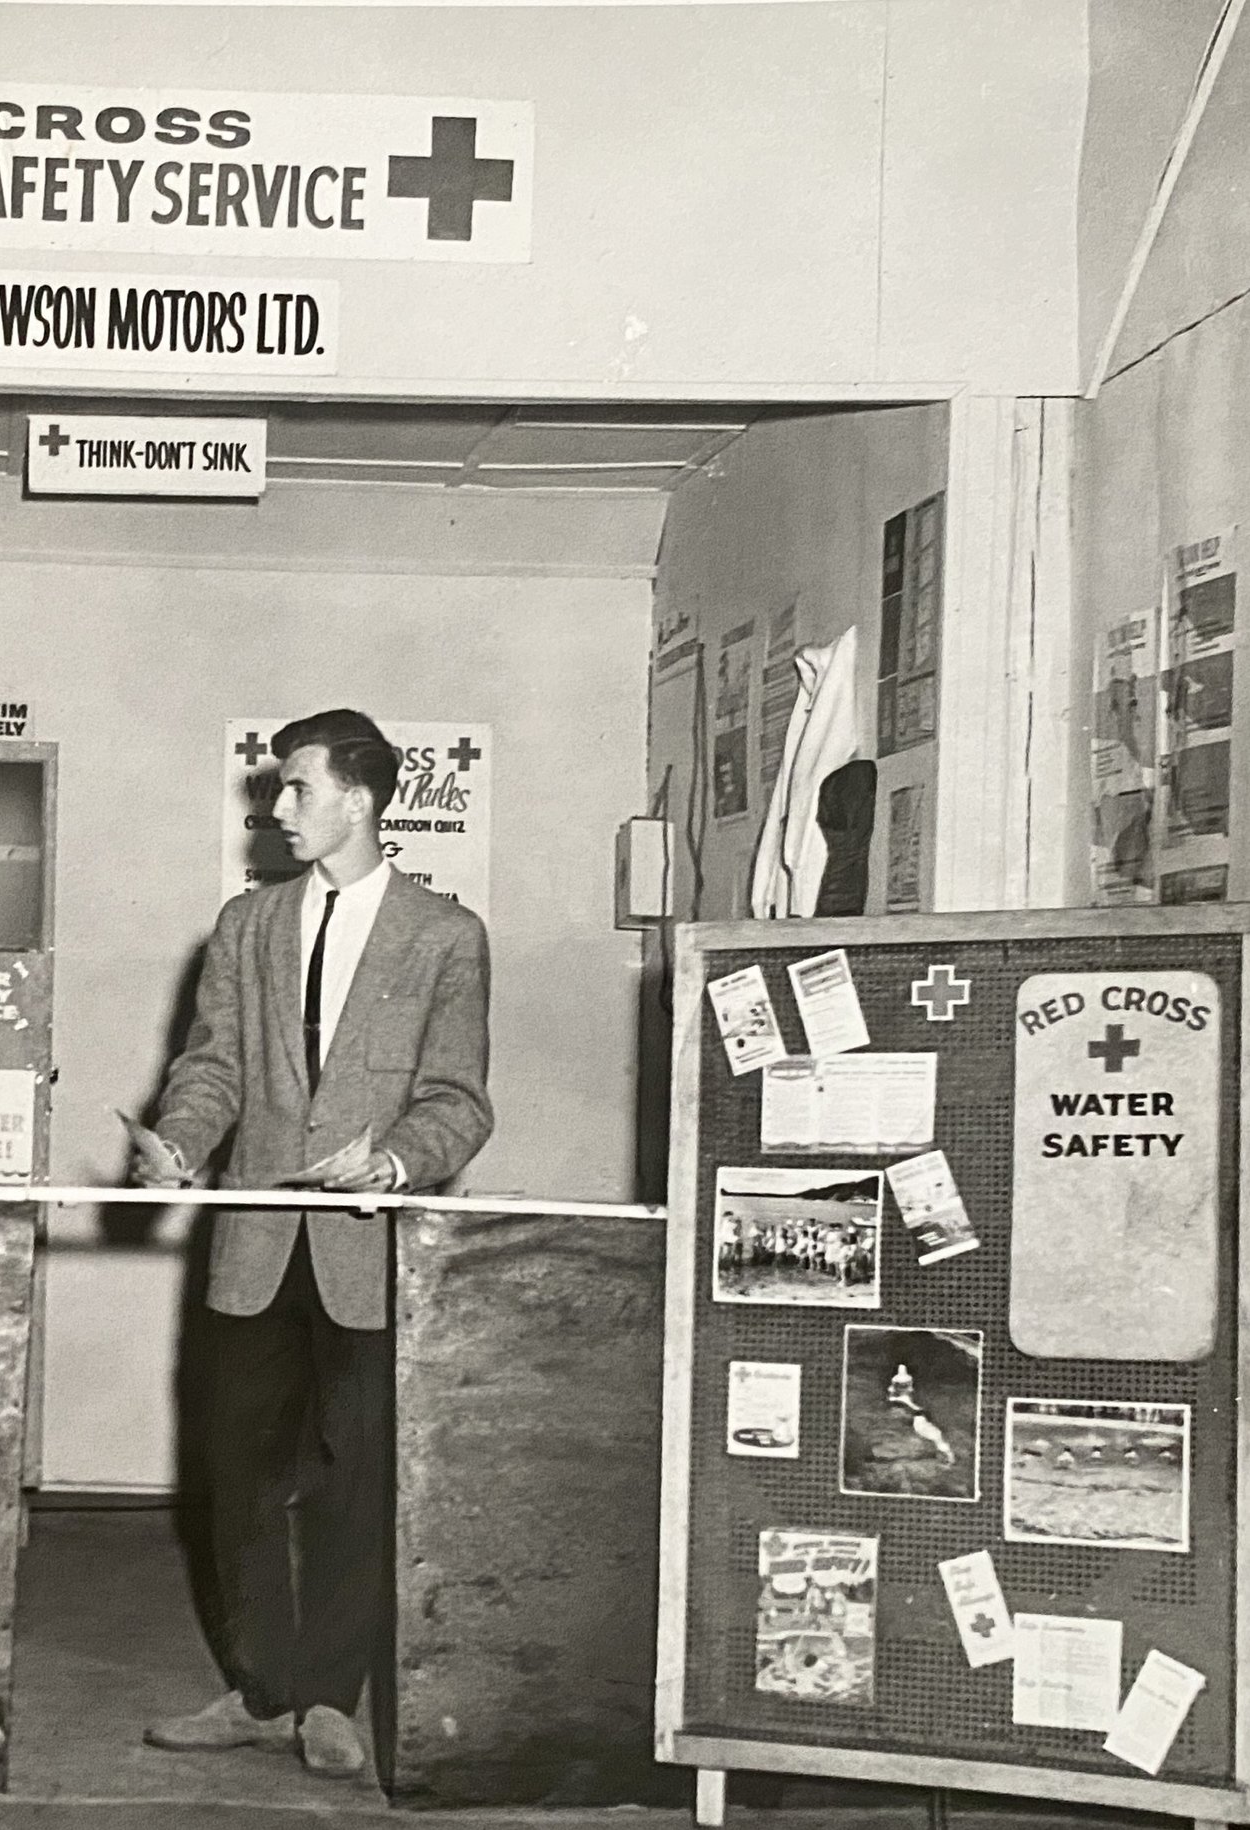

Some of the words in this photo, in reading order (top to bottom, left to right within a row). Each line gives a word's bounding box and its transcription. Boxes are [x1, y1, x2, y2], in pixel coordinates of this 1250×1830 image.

[150, 161, 367, 231] SERVICE
[107, 289, 245, 354] MOTORS
[255, 292, 325, 358] LTD.
[202, 442, 251, 473] SINK
[408, 771, 472, 813] Rules
[434, 819, 466, 833] QUIZ
[1019, 992, 1085, 1036] RED
[1101, 986, 1211, 1031] CROSS
[1050, 1092, 1174, 1117] WATER
[1041, 1132, 1185, 1158] SAFETY
